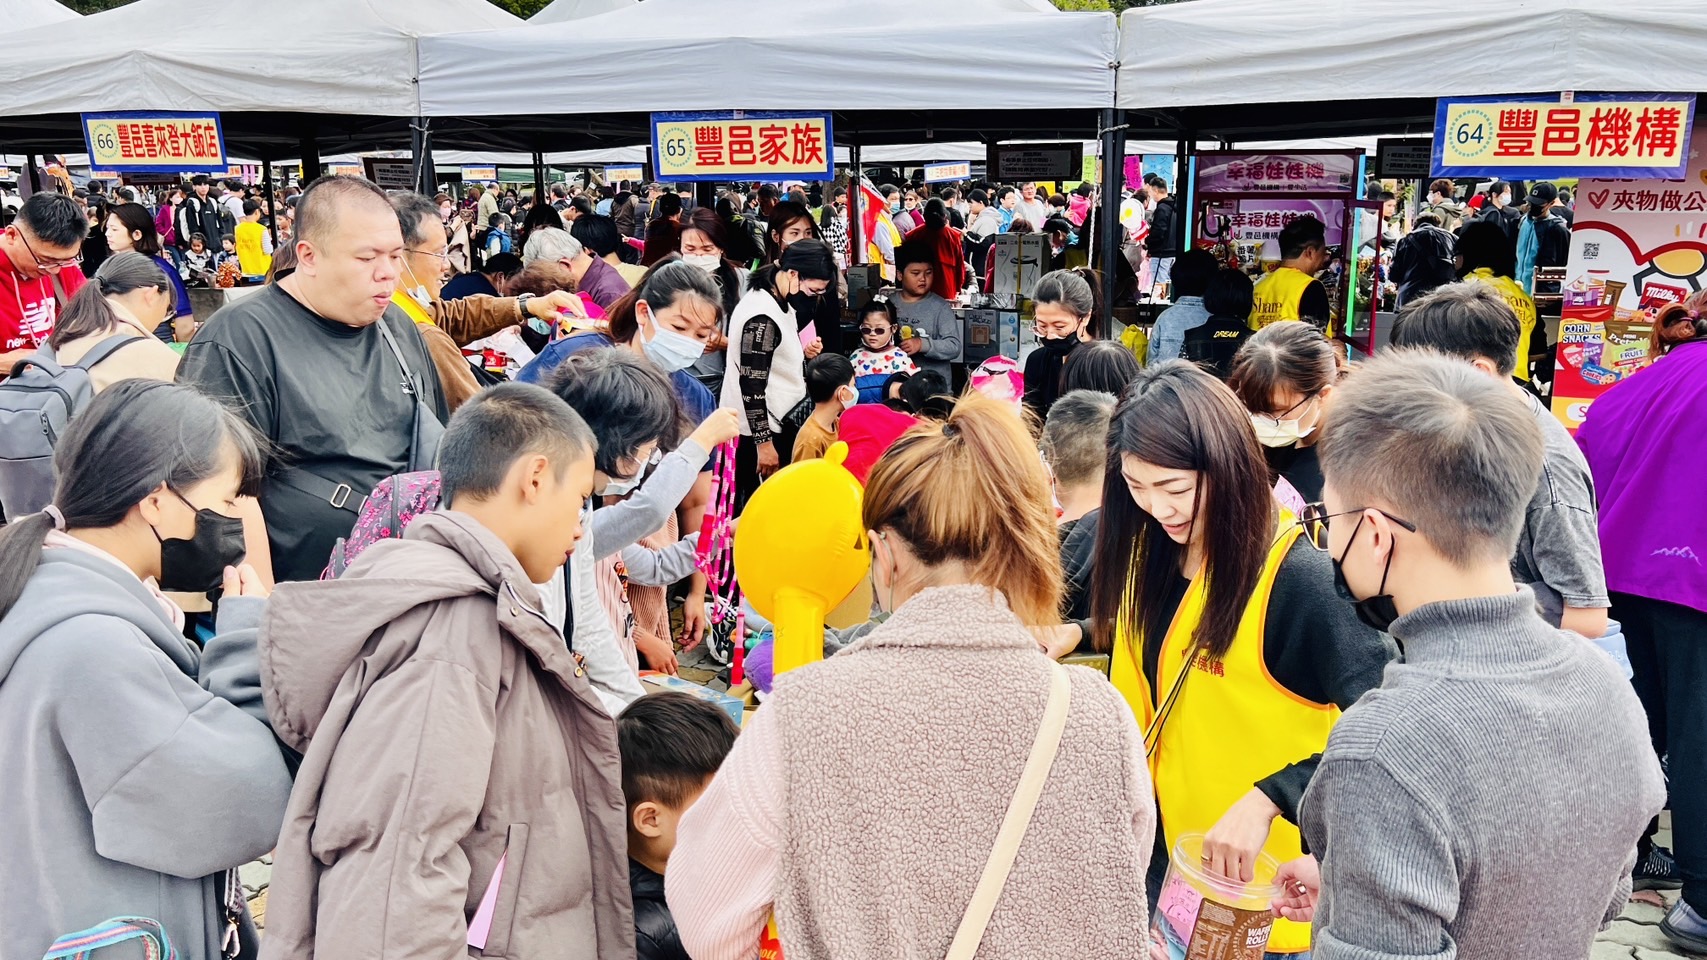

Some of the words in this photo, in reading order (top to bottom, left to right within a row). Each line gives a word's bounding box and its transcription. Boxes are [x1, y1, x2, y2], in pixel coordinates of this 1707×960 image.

[97, 133, 114, 149] 66
[117, 122, 219, 158] 豐邑喜來登大飯店
[1457, 123, 1484, 144] 64
[1493, 107, 1681, 158] 豐邑機構
[666, 139, 686, 156] 65
[694, 123, 823, 166] 豐邑家族
[1611, 189, 1707, 212] 夾物做公
[1645, 285, 1680, 302] Milky
[1563, 323, 1591, 333] CORN
[1620, 349, 1643, 359] FRUIT
